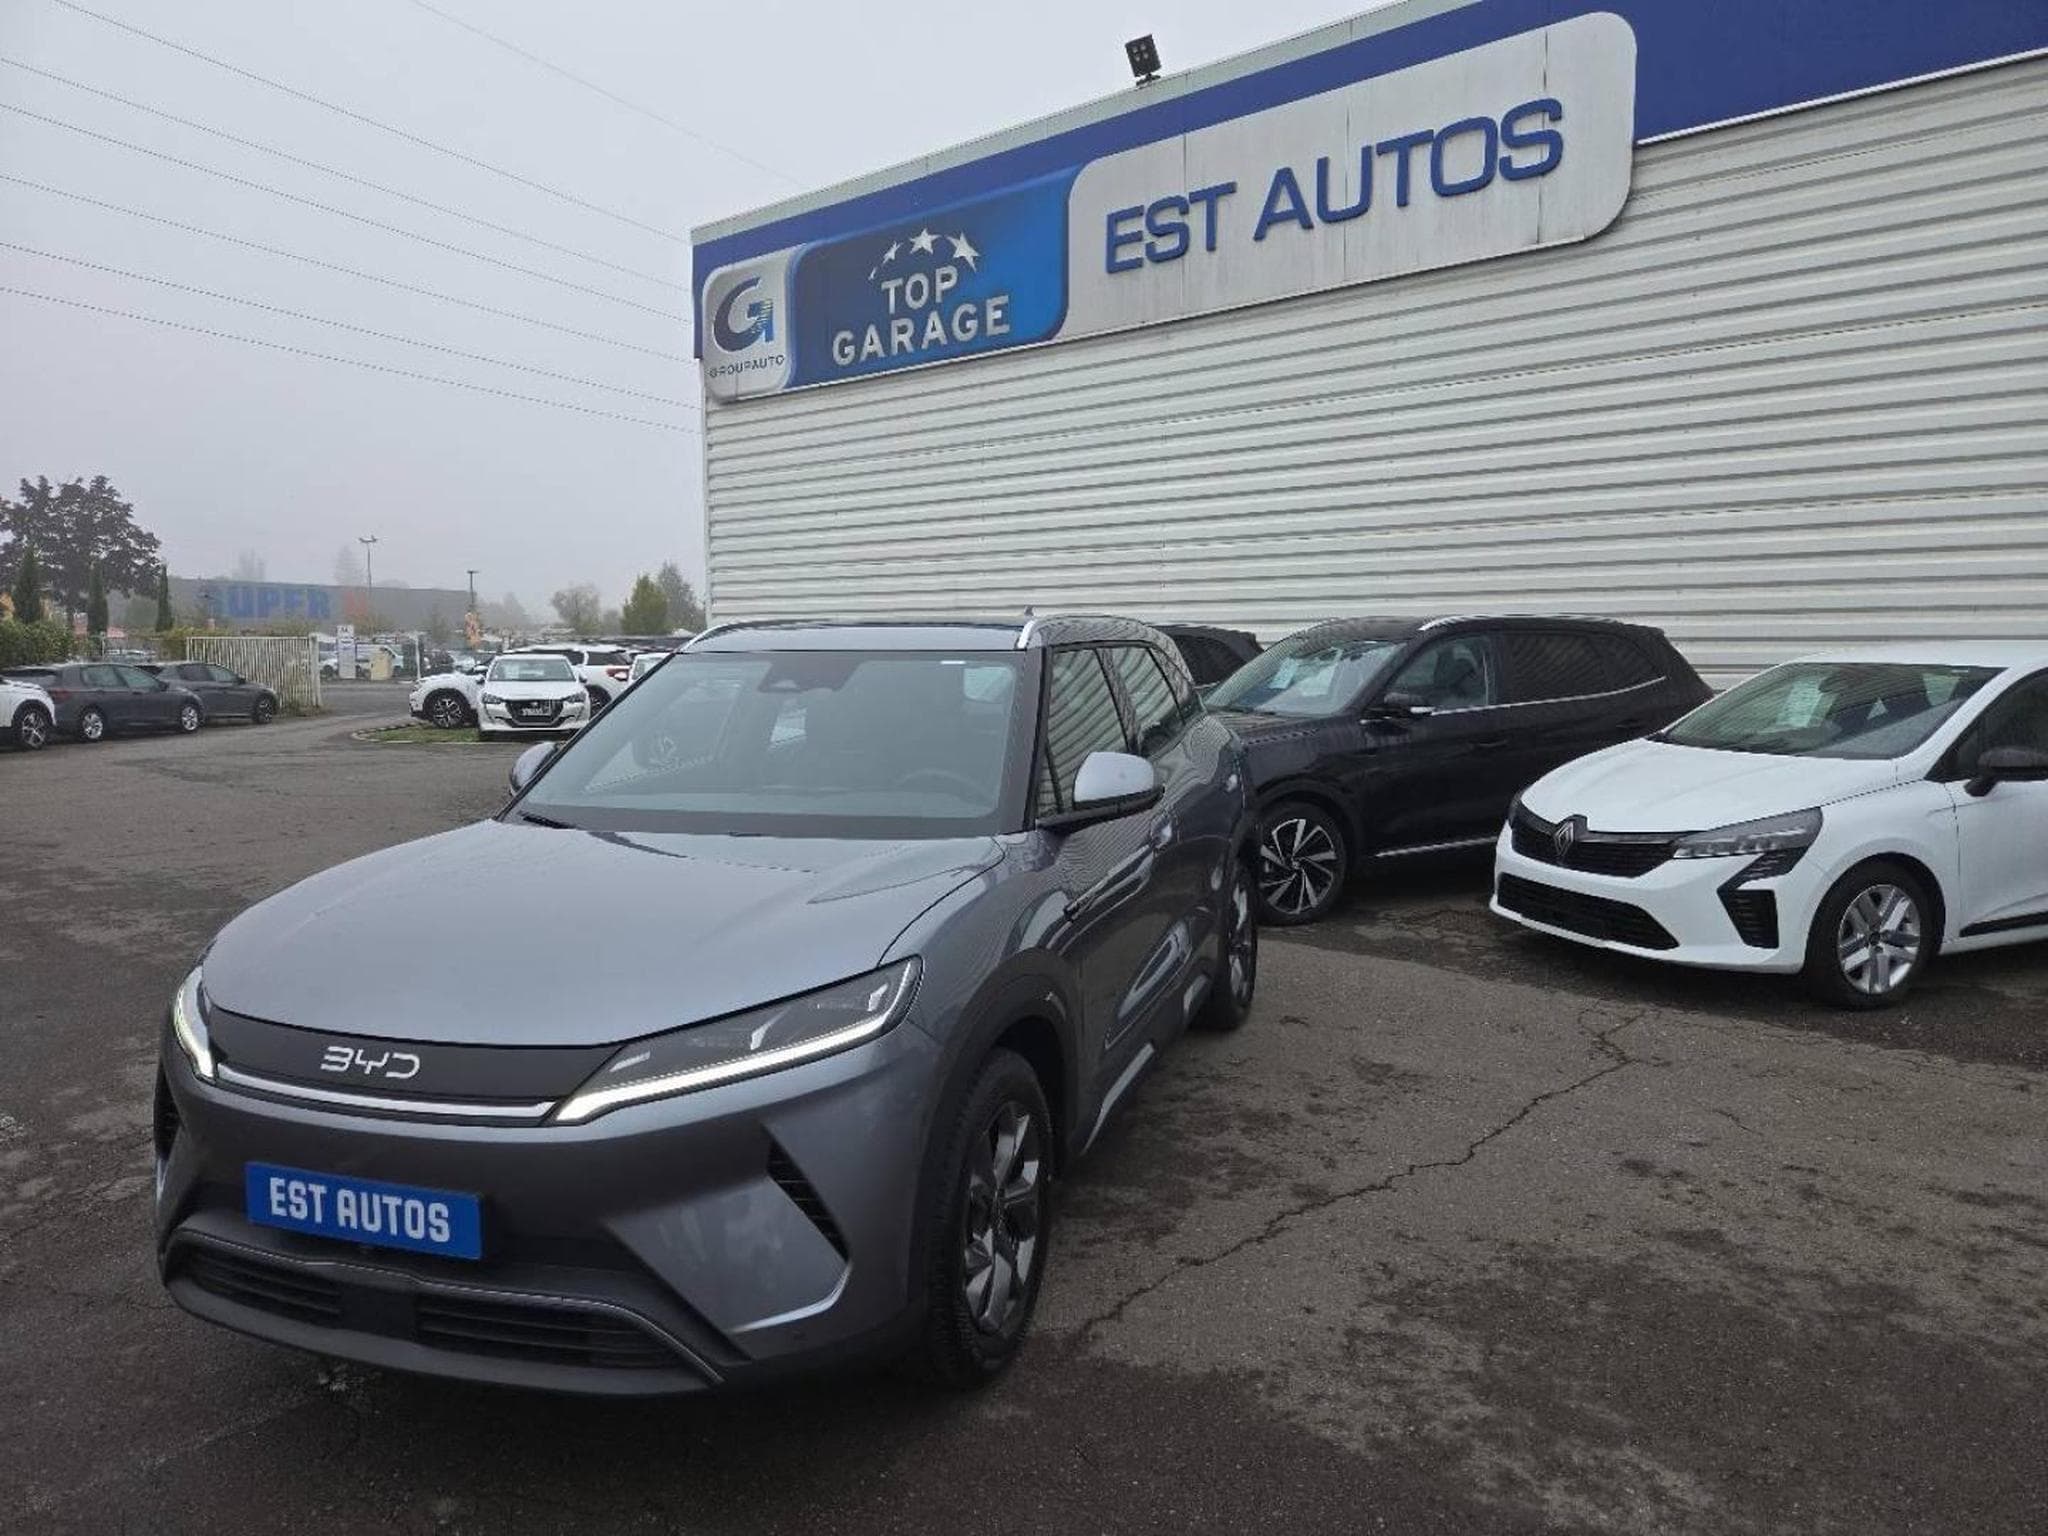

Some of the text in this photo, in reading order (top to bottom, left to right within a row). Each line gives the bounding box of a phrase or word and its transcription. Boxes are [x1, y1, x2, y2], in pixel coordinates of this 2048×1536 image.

[1106, 98, 1563, 273] EST AUTOS
[881, 265, 959, 314] TOP
[832, 295, 1011, 366] GARAGE
[320, 1046, 420, 1079] BYD
[269, 1177, 450, 1243] EST AUTOS
